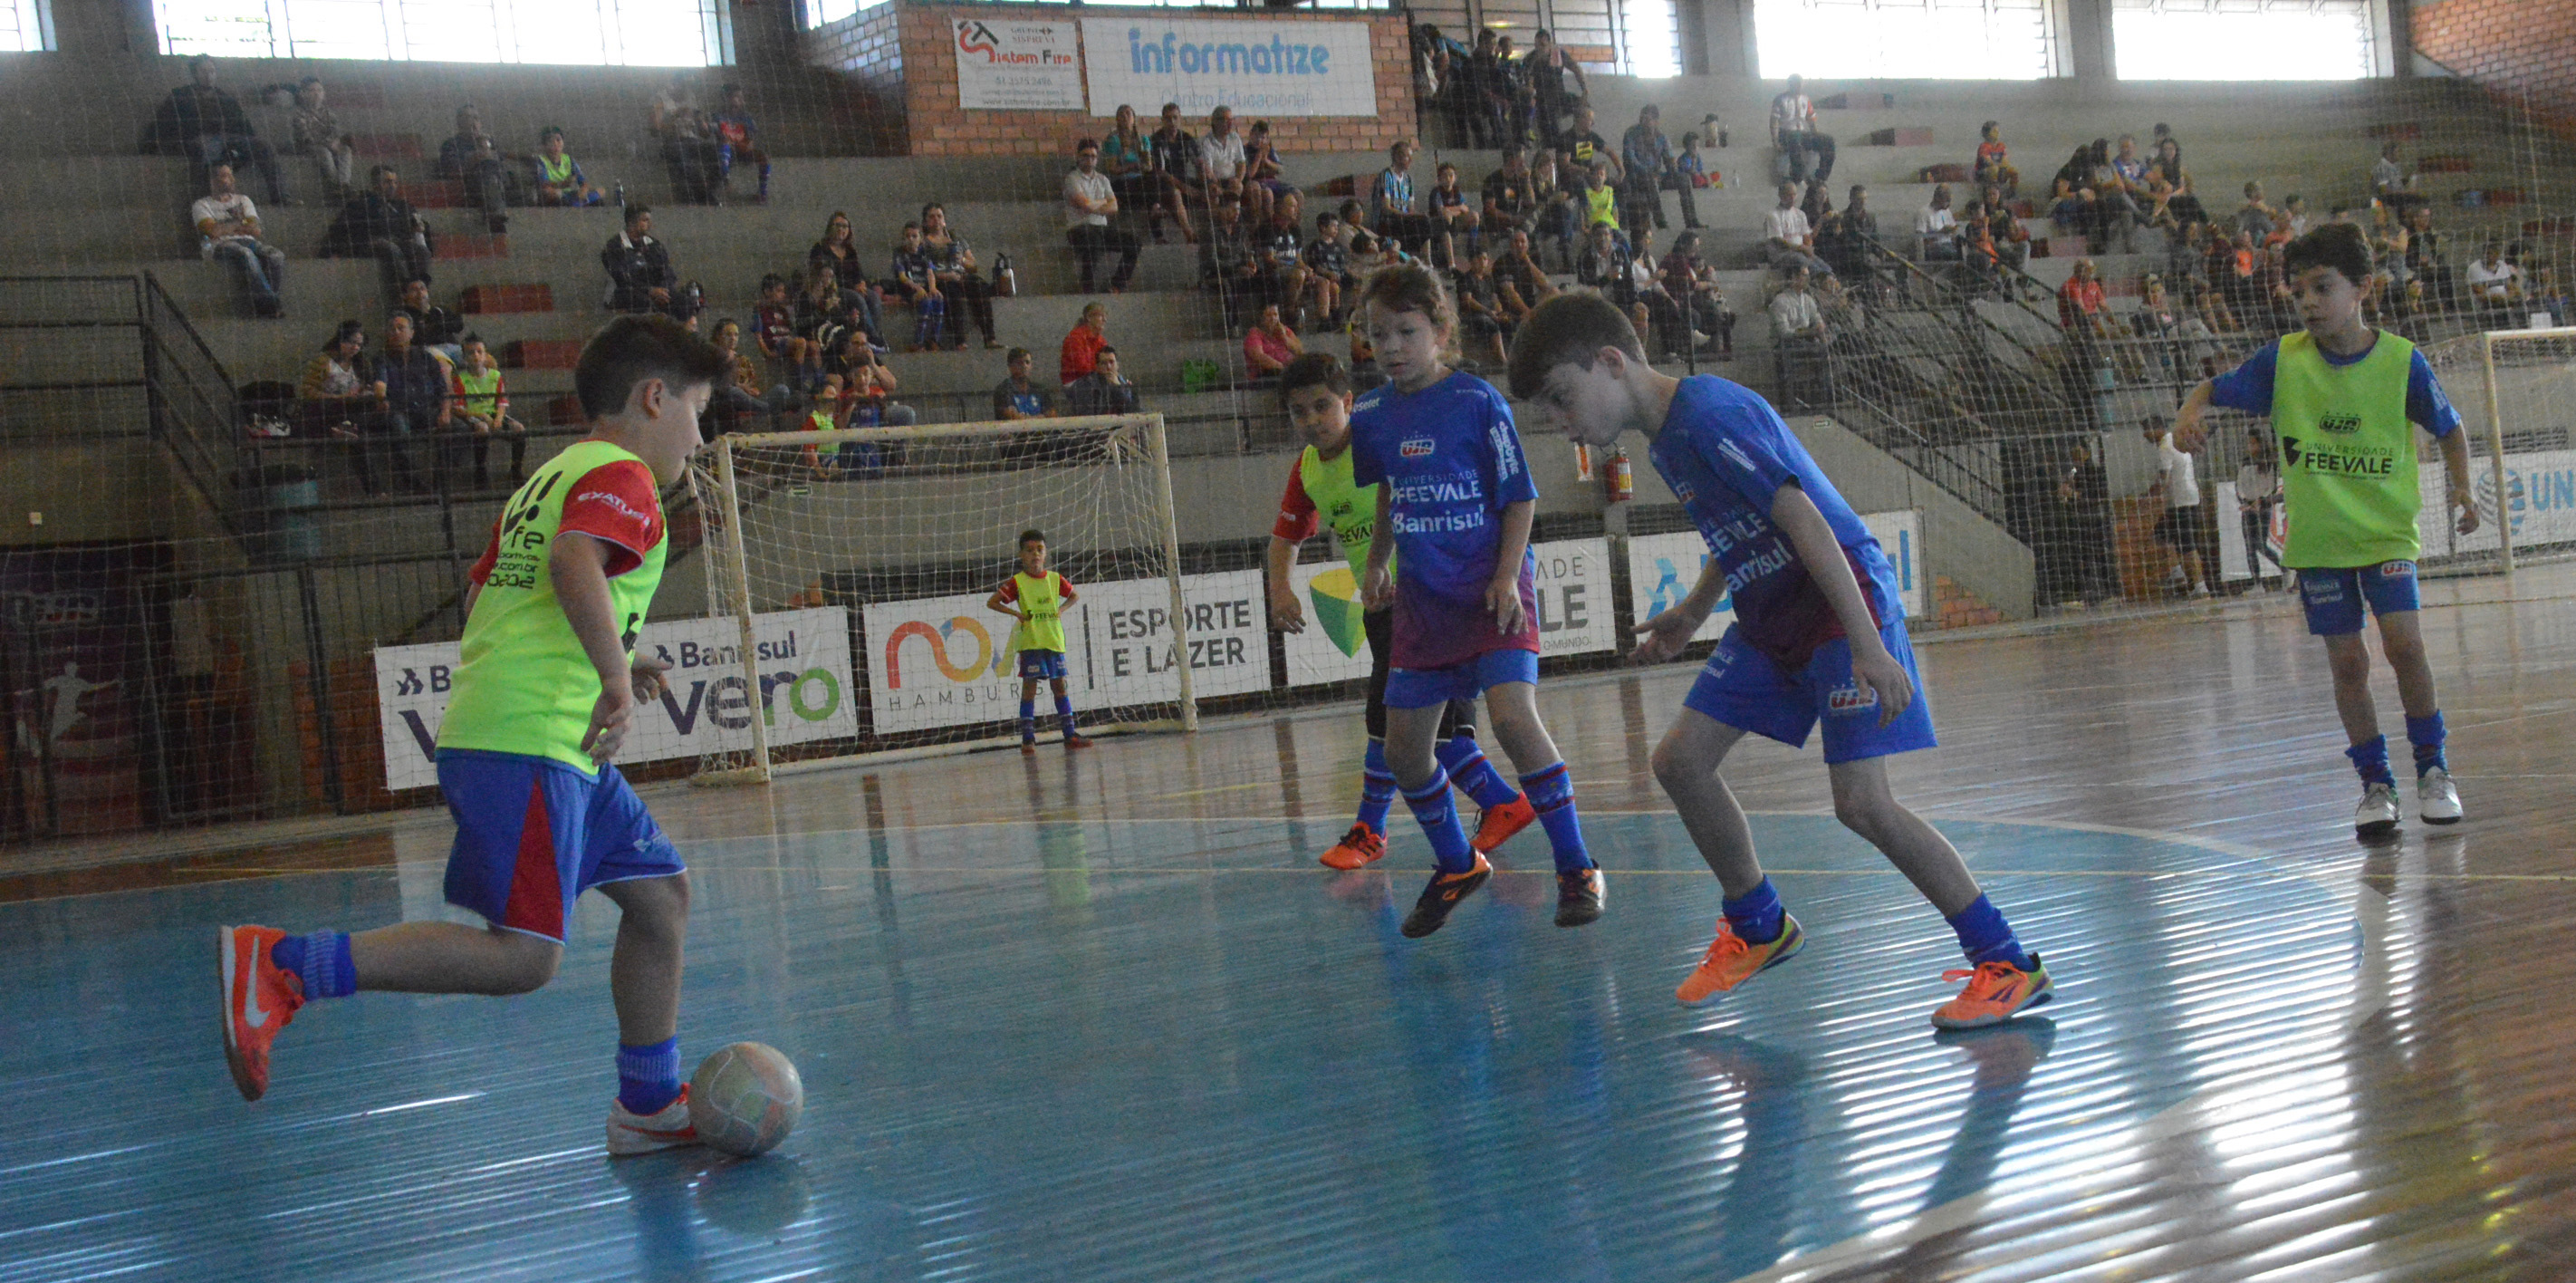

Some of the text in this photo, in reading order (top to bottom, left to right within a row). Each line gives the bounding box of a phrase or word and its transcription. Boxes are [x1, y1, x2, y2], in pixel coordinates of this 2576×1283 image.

[1043, 50, 1072, 64] Fire
[1129, 28, 1330, 74] informatize
[1161, 88, 1311, 107] Centro Educacional
[2306, 442, 2394, 456] UNIVERSIDADE
[2305, 453, 2393, 474] FEEVALE
[1396, 479, 1482, 504] FEEVALE
[1393, 504, 1485, 534] Banrisul
[1725, 536, 1793, 592] anrisul
[1112, 648, 1130, 677] E
